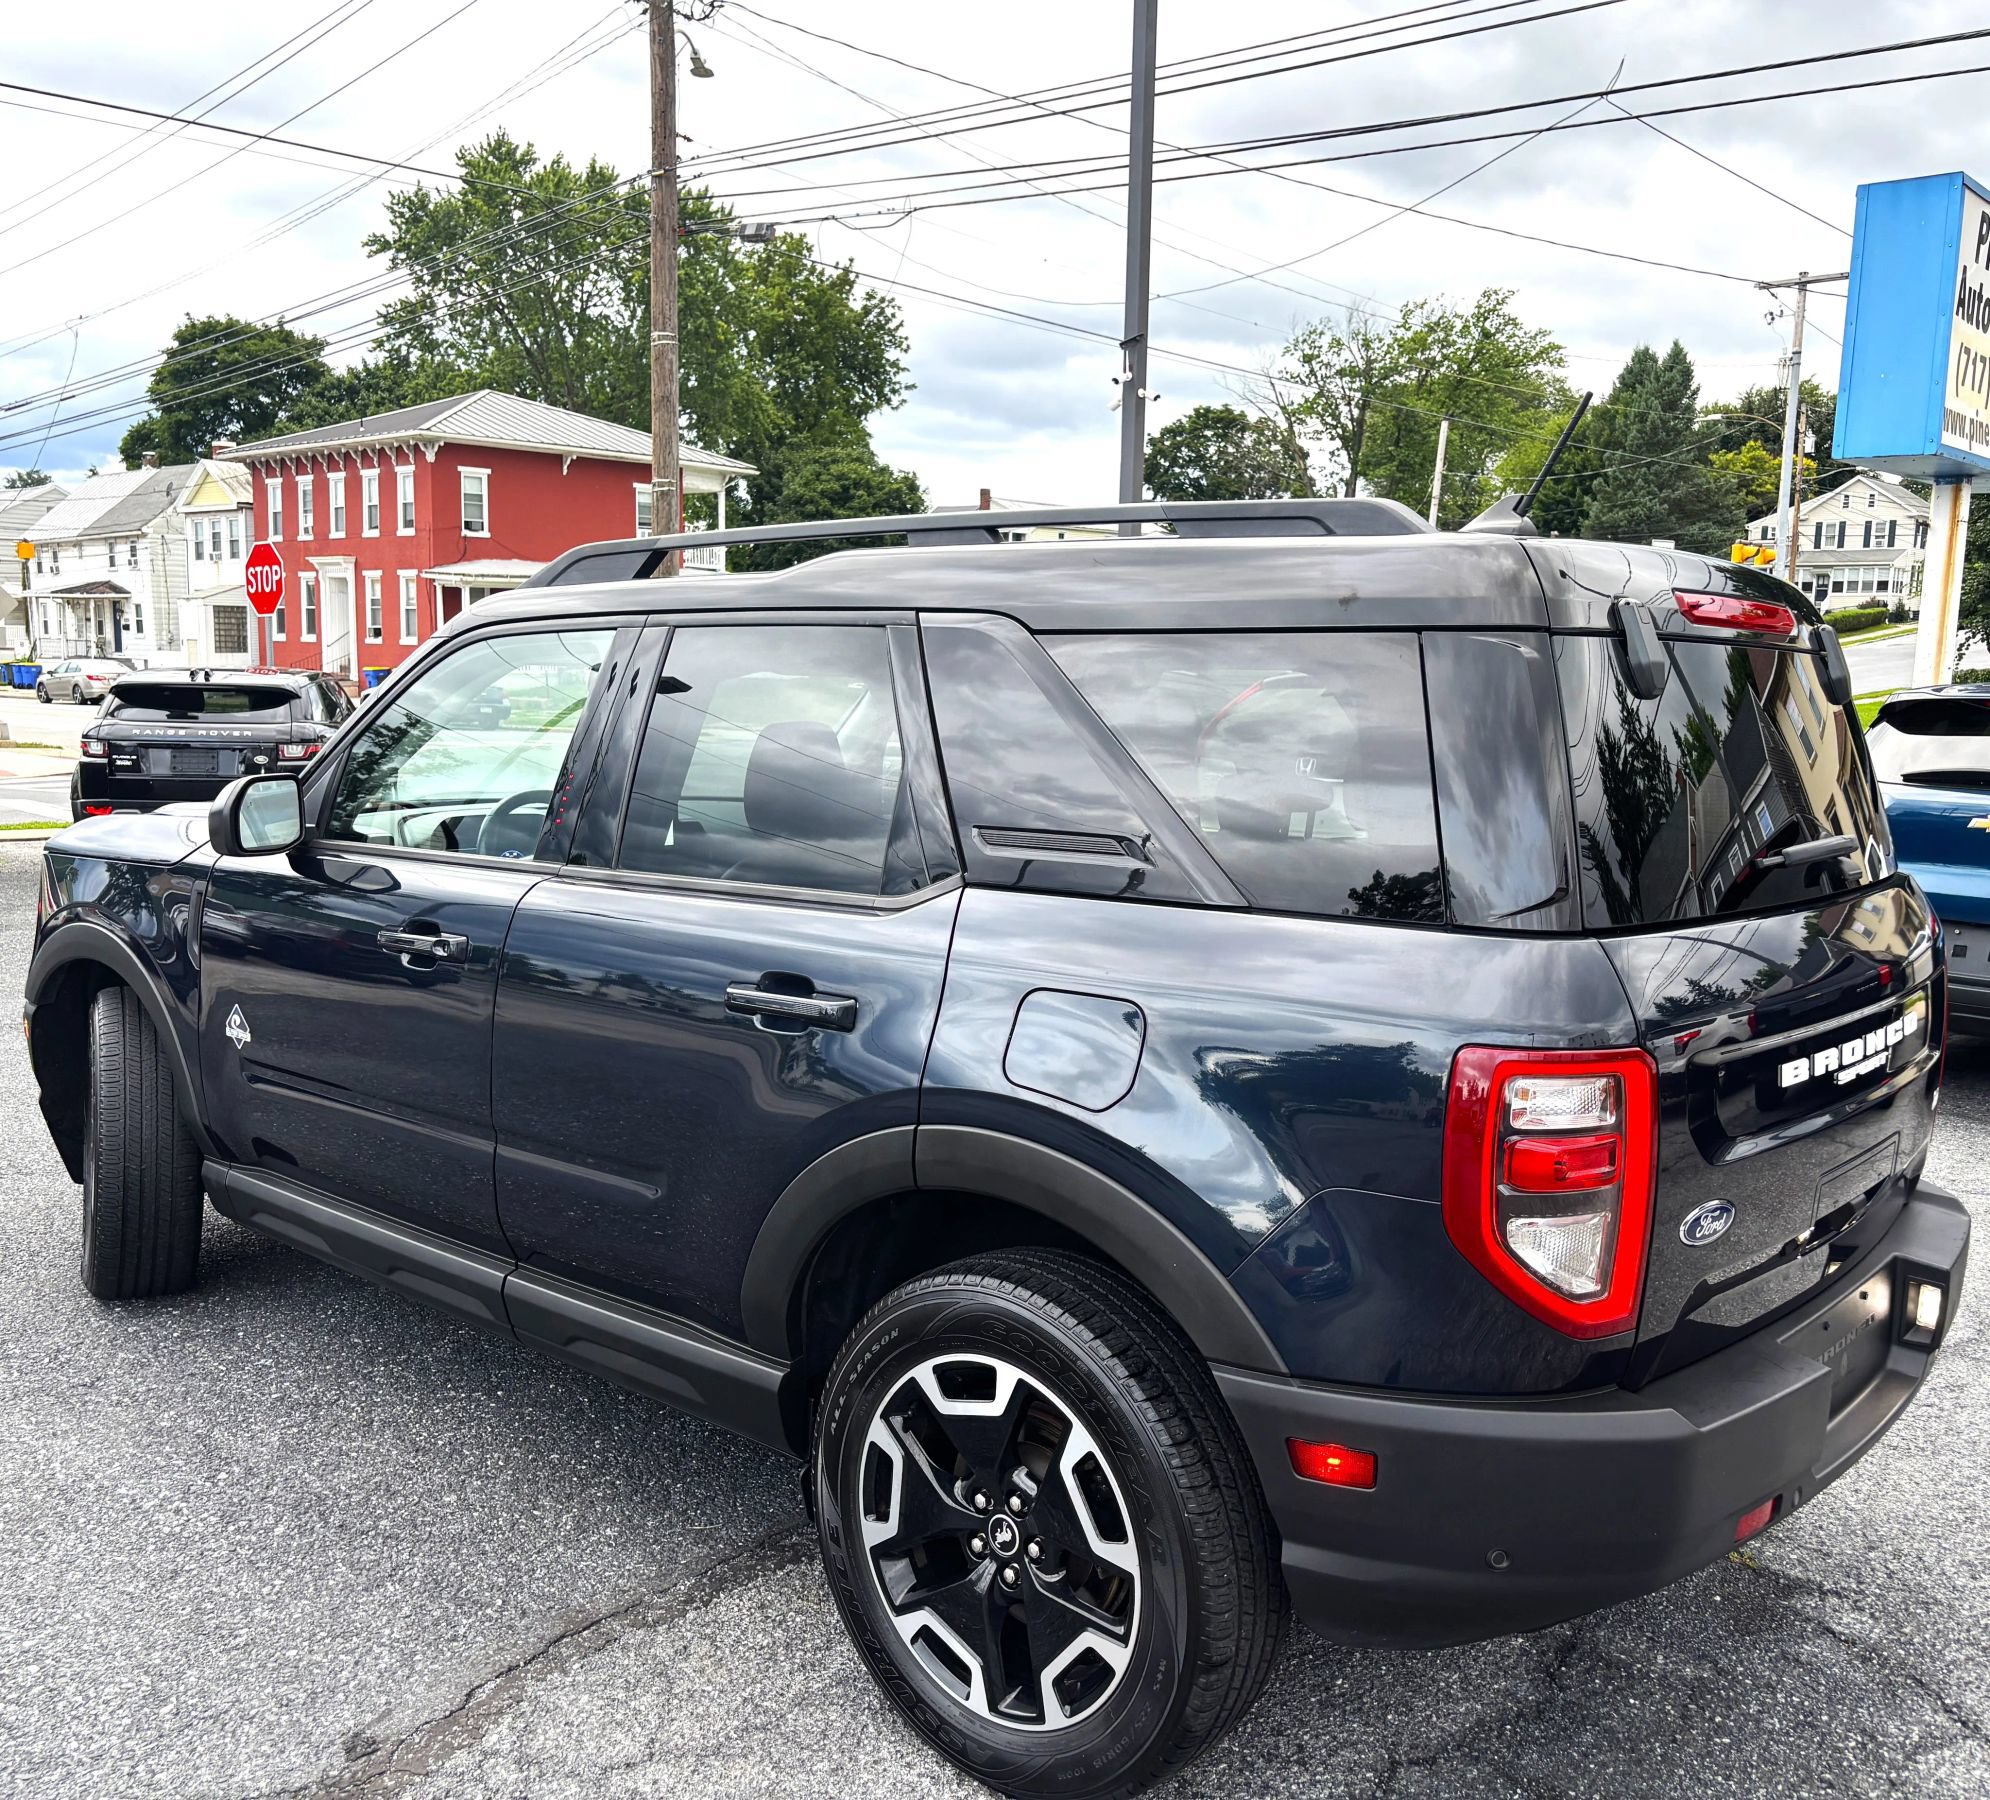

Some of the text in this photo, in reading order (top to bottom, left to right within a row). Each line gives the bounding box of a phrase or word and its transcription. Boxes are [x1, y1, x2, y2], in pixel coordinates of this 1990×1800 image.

[1975, 210, 1990, 271] P
[247, 564, 281, 593] STOP
[199, 729, 252, 737] ROVER
[1778, 1011, 1918, 1088] BRONCO
[1834, 1051, 1889, 1085] SPORT
[1696, 1211, 1727, 1239] Ford
[830, 1328, 900, 1436] ALL-SEASON
